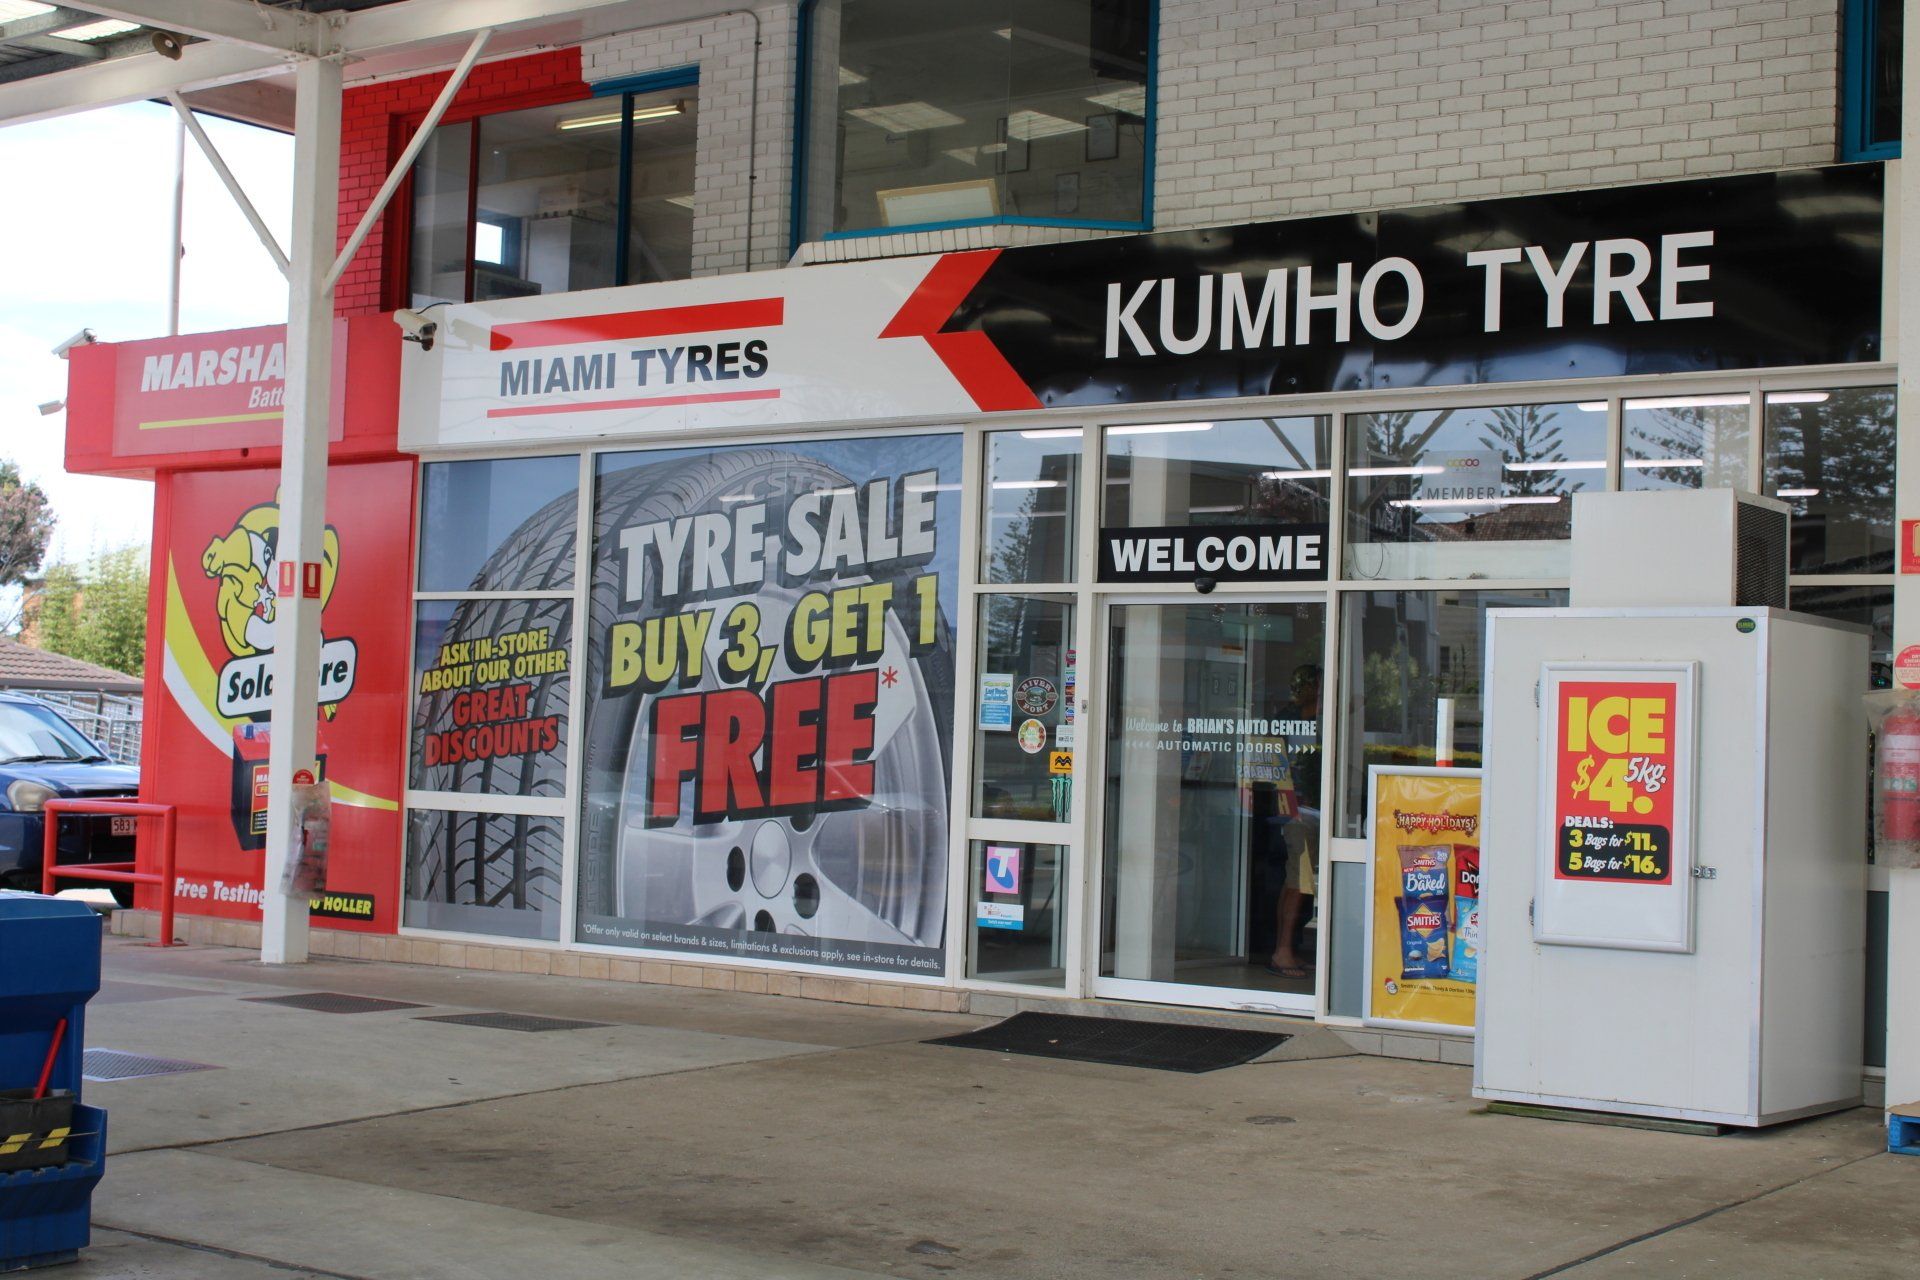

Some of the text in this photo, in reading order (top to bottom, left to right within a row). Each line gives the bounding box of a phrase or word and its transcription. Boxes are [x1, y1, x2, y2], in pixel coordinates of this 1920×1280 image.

[1105, 230, 1715, 360] KUMHO TYRE
[140, 342, 286, 392] MARSHA
[500, 339, 769, 397] MIAMI TYRES
[248, 386, 286, 408] Batt
[1427, 487, 1496, 500] MEMBER
[619, 471, 937, 602] TYRE SALE
[1110, 534, 1321, 572] WELCOME
[610, 575, 937, 688] BUY 3, GET 1
[440, 628, 549, 667] ASK IN-STORE
[420, 650, 568, 693] ABOUT OUR OTHER
[1022, 679, 1053, 692] RIVER
[453, 684, 532, 727] GREAT
[1022, 702, 1049, 713] PORT
[1126, 716, 1317, 736] Welcome to BRIAN'S AUTO CENTRE
[1567, 696, 1666, 754] ICE
[424, 716, 559, 768] DISCOUNTS
[1157, 740, 1282, 754] AUTOMATIC DOORS
[1399, 815, 1474, 828] HAPPY HOLIDAYS!
[1565, 815, 1614, 829] DEALS:
[1569, 829, 1658, 852] 3 Bags for $11.
[1568, 852, 1662, 875] 5 Bags for $16.
[174, 877, 208, 900] Free
[1405, 872, 1446, 892] Baked
[1461, 871, 1480, 884] Dor
[324, 896, 372, 915] HOLLER
[1407, 915, 1441, 928] SMITH'S
[1464, 926, 1478, 939] Thin
[605, 926, 620, 939] only
[622, 927, 639, 939] valid
[640, 932, 651, 940] on
[652, 932, 673, 943] select
[674, 933, 700, 946] brands
[701, 937, 708, 946] &
[709, 938, 729, 950] sizes,
[730, 939, 770, 952] limitations
[772, 944, 779, 953] &
[780, 944, 820, 958] exclusions
[821, 950, 845, 962] apply,
[847, 952, 861, 962] see
[863, 952, 895, 966] in-store
[896, 954, 909, 966] for
[910, 956, 941, 970] details.
